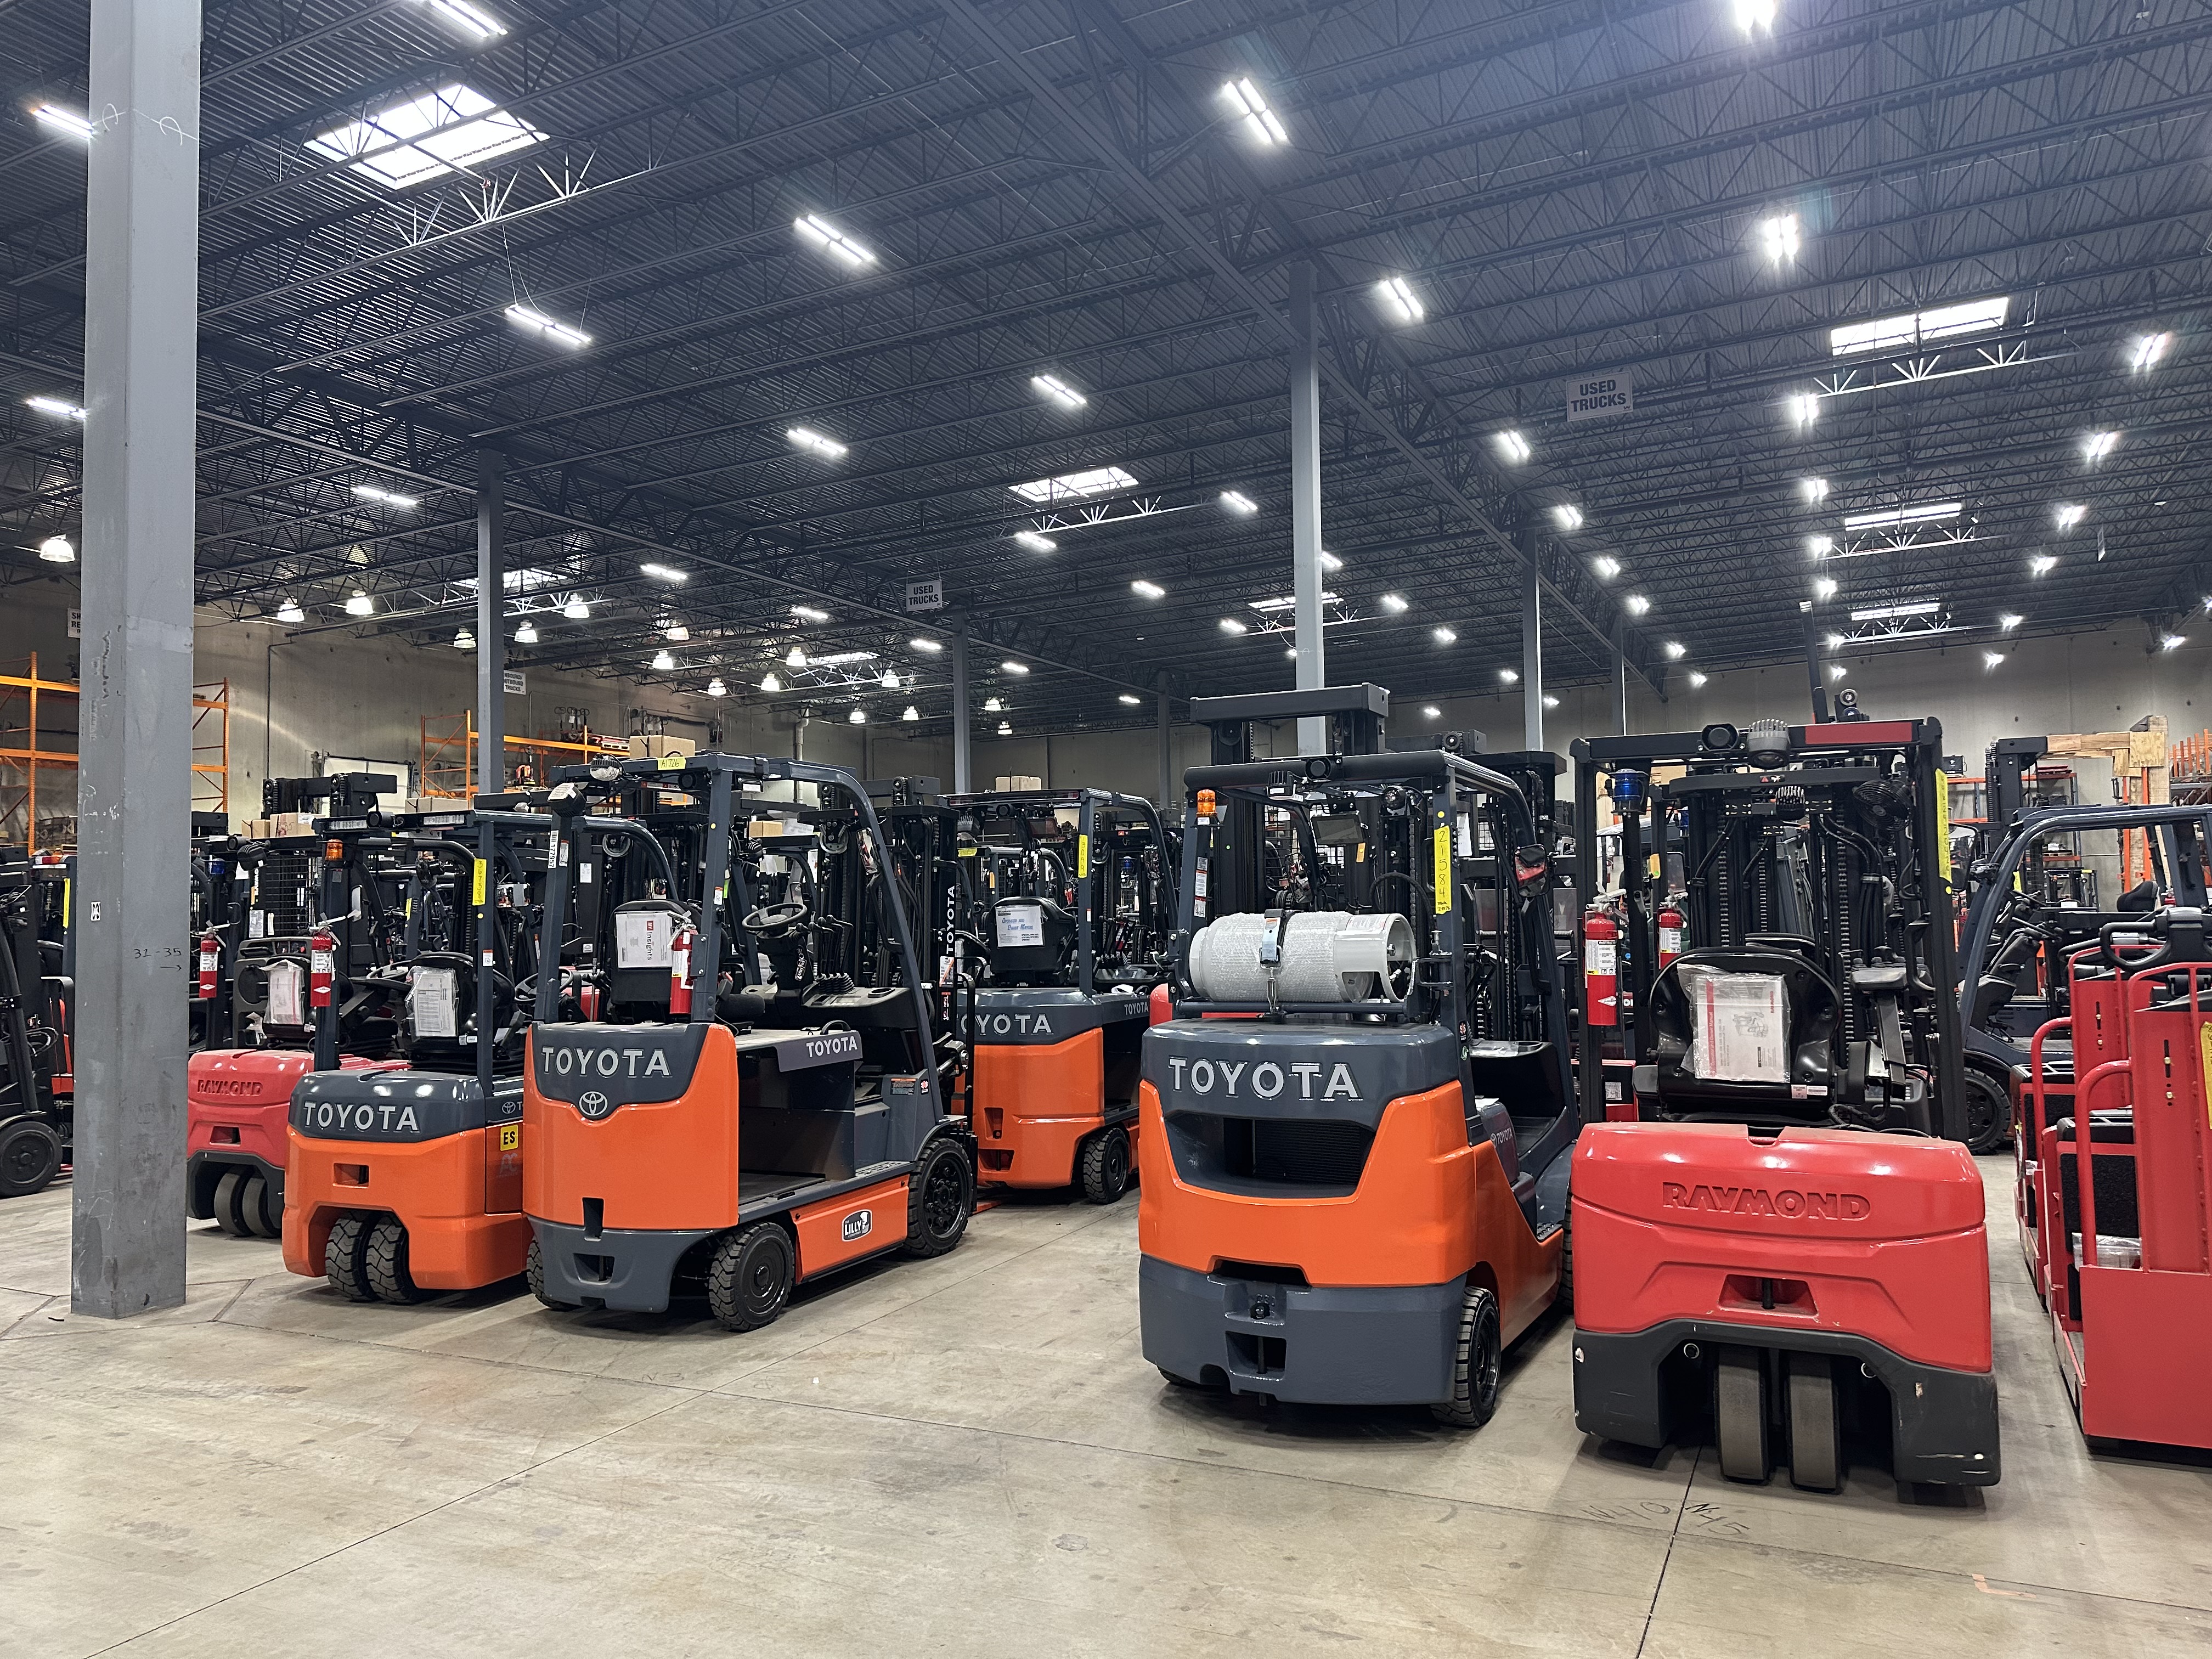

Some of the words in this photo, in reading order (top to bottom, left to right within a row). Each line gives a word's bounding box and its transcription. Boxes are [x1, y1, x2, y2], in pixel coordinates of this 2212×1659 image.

[1580, 379, 1616, 396] USED
[1571, 392, 1627, 412] TRUCKS
[909, 594, 939, 605] TRUCKS
[913, 585, 934, 595] USED
[661, 759, 680, 768] A1726
[1438, 830, 1448, 898] 21584
[92, 903, 100, 920] C3
[946, 885, 955, 955] TOYOTA
[646, 932, 654, 961] Insights
[1124, 1002, 1149, 1016] TOYOTA
[956, 1013, 1053, 1035] YOTA
[806, 1036, 858, 1058] TOYOTA
[541, 1047, 671, 1077] TOYOTA
[197, 1079, 263, 1097] RAYMOND
[1169, 1057, 1362, 1101] TOYOTA
[303, 1101, 419, 1133] TOYOTA
[503, 1131, 516, 1145] ES
[1496, 1127, 1513, 1144] TOYOTA
[1662, 1181, 1871, 1222] RAYMOND
[845, 1220, 862, 1235] LILLY
